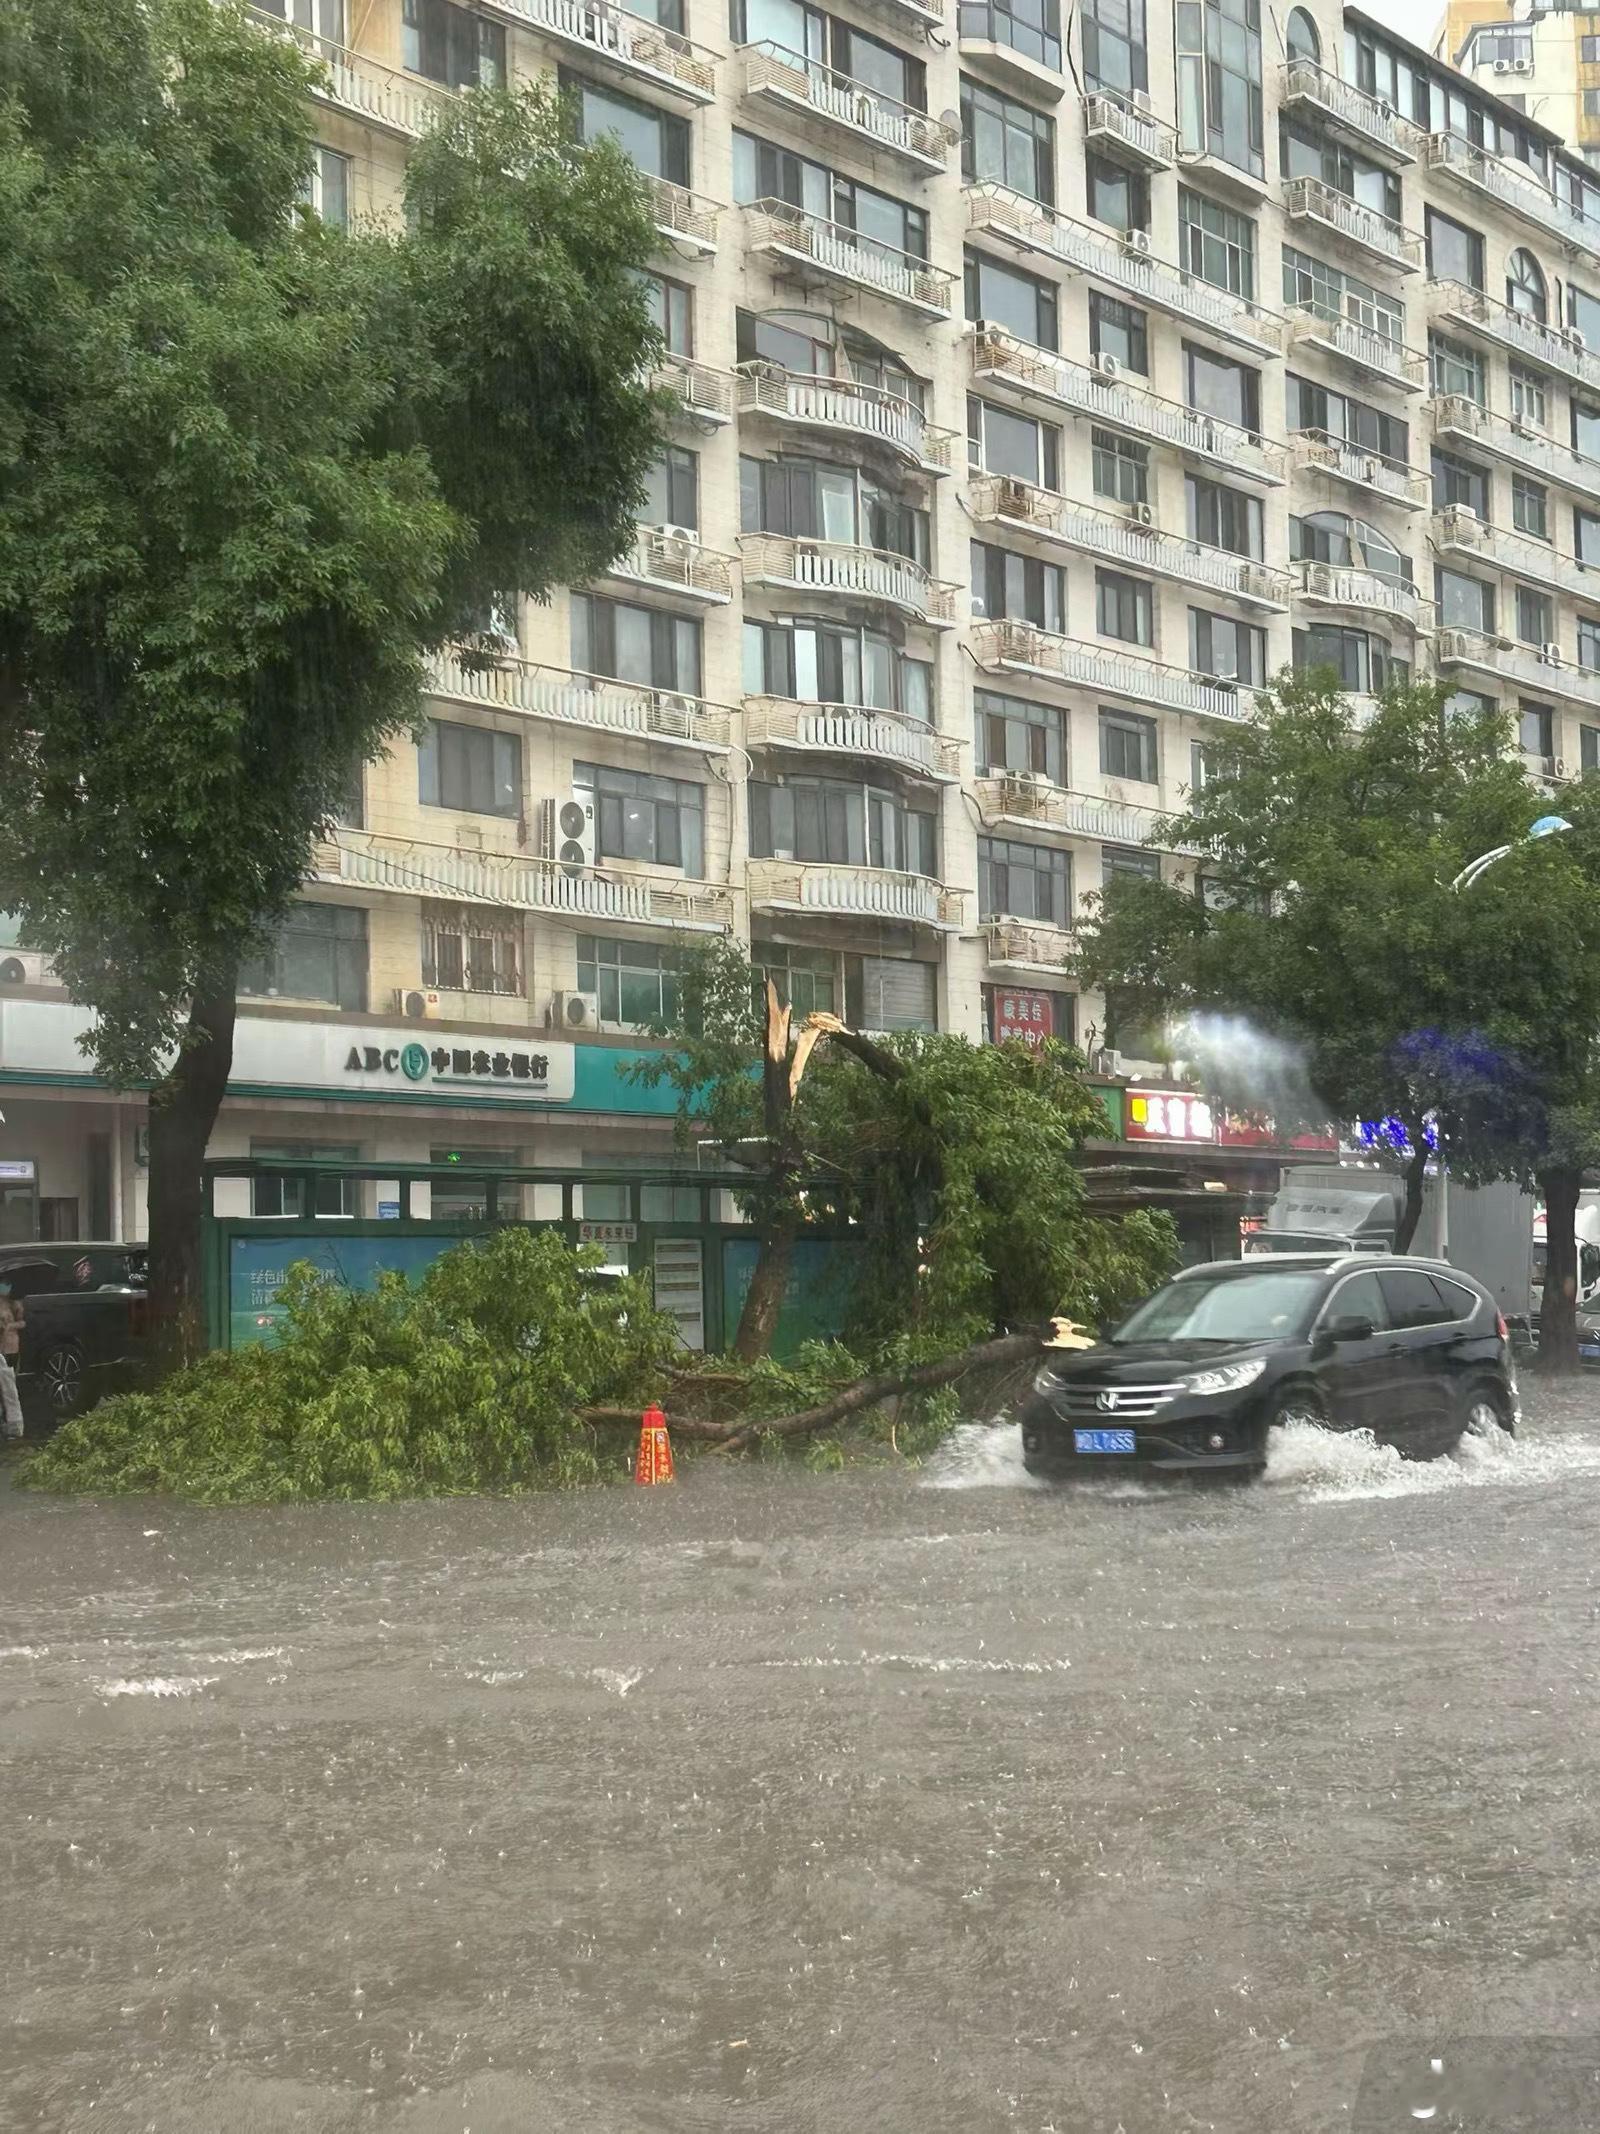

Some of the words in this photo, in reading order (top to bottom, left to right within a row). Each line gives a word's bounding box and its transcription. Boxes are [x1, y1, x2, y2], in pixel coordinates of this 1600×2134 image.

[345, 1046, 400, 1073] ABC
[431, 1046, 550, 1080] 中国农业银行
